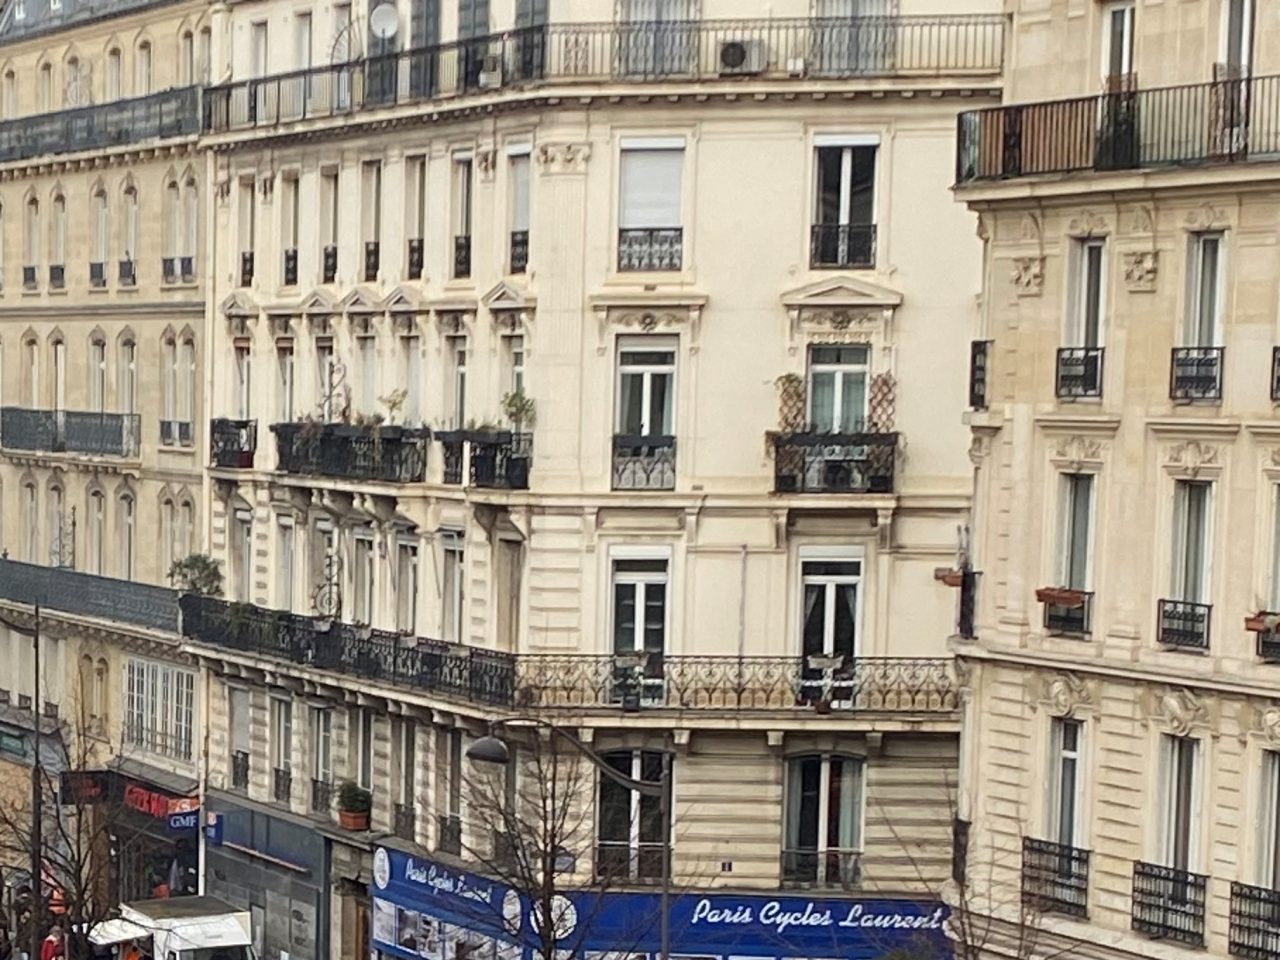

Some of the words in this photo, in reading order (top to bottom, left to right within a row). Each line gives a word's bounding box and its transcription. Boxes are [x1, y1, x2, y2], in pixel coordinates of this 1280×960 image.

[170, 815, 197, 828] GMF
[691, 899, 754, 925] Paris
[759, 901, 834, 932] Cycles
[838, 904, 942, 929] Laurent
